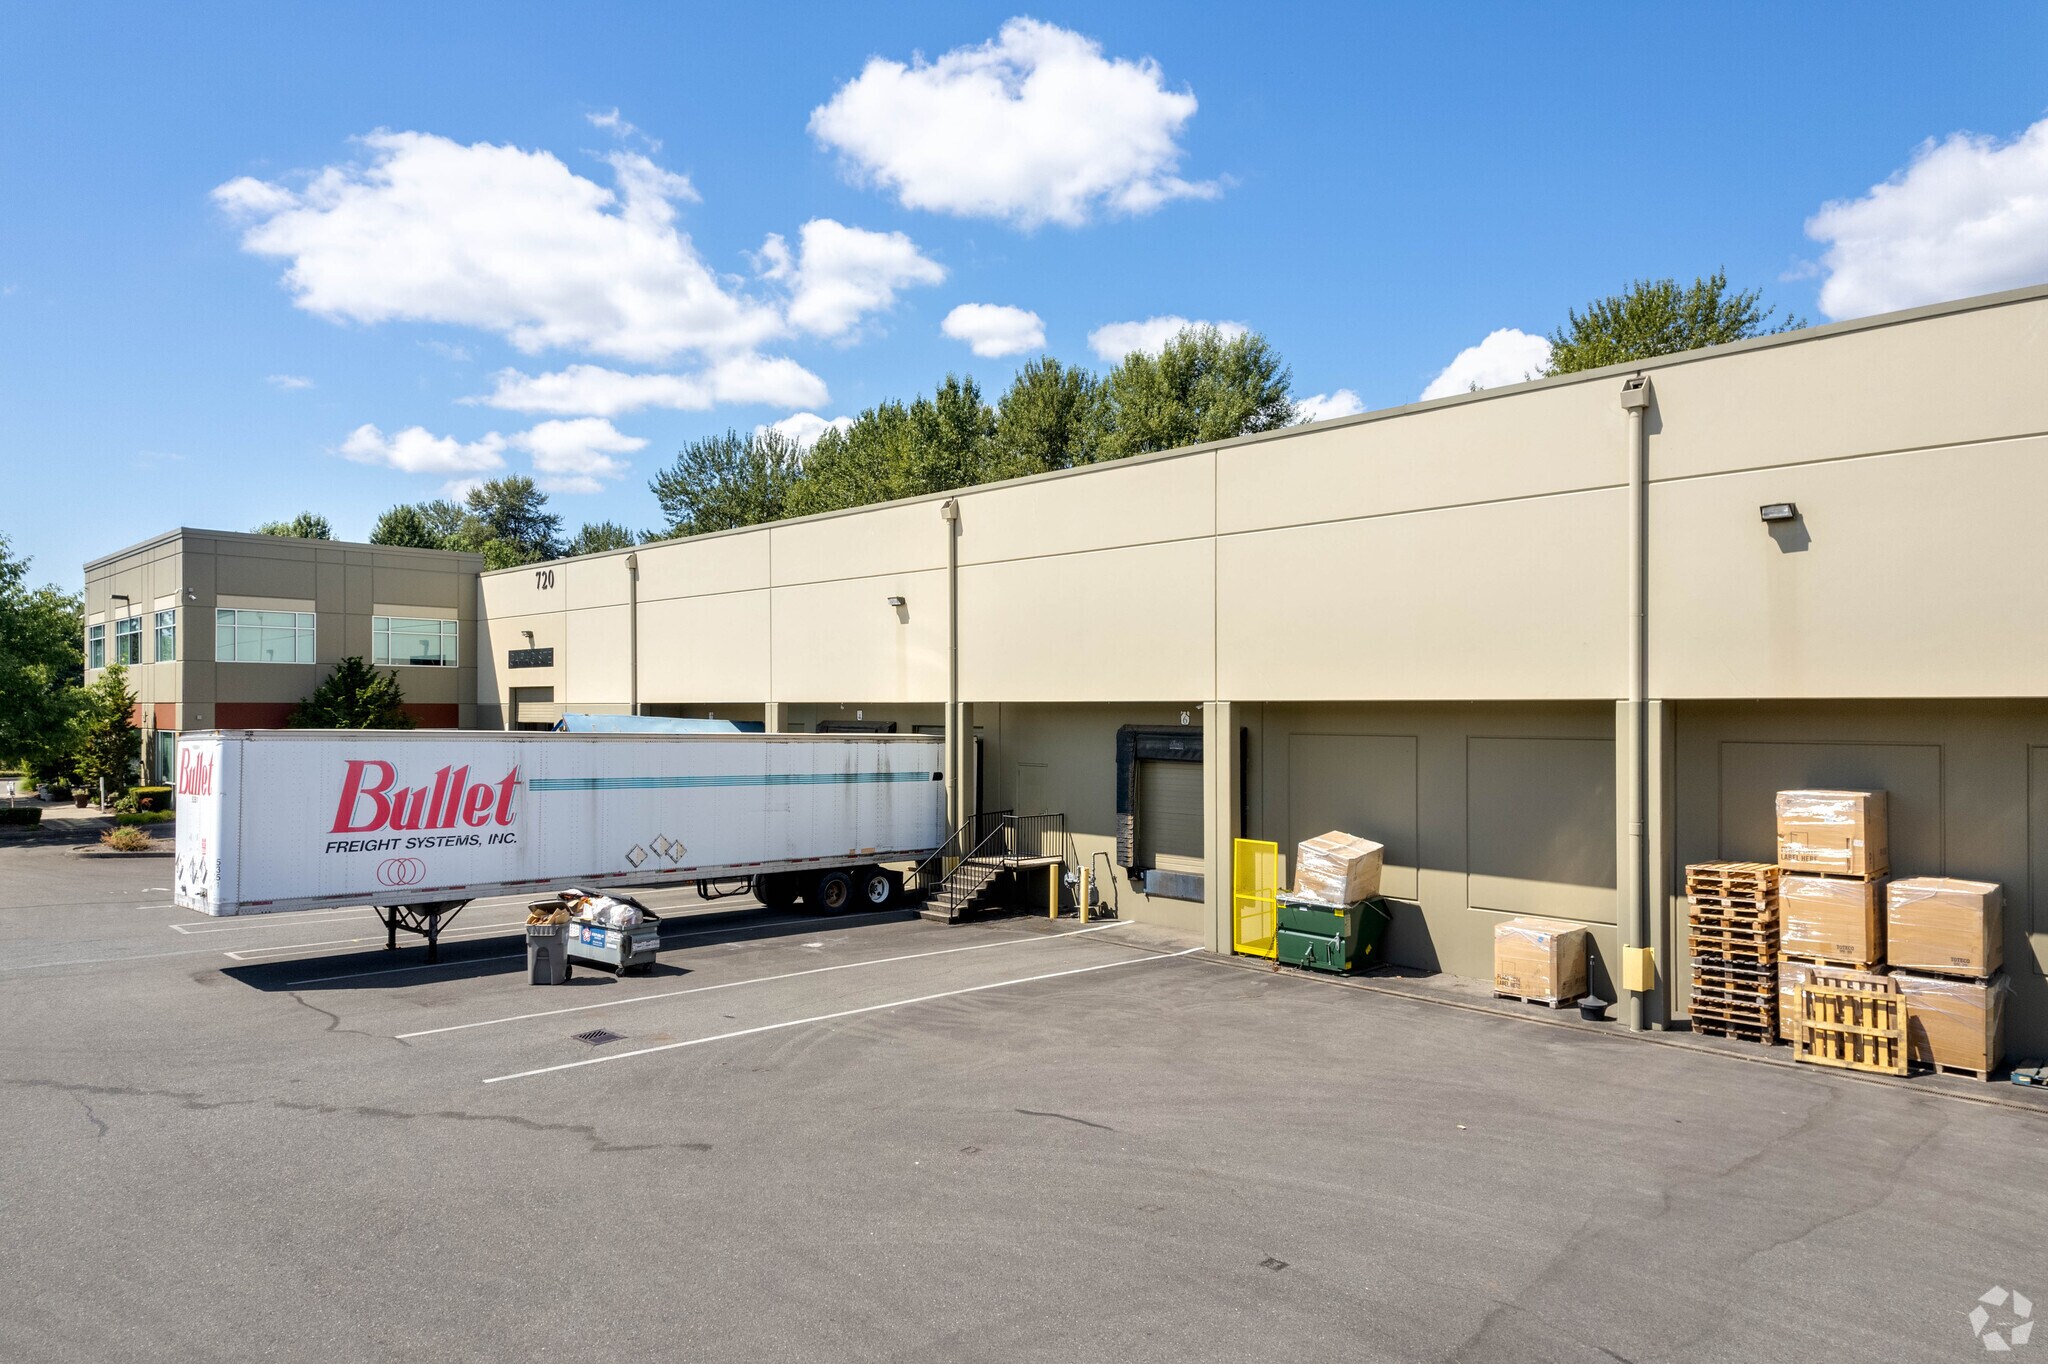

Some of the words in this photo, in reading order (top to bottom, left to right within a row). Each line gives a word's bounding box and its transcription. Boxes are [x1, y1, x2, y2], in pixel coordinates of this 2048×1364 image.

[535, 570, 554, 590] 720
[178, 747, 214, 797] Bullet
[327, 760, 523, 834] Bullet
[325, 838, 402, 854] FREIGHT
[405, 834, 482, 849] SYSTEMS,
[488, 832, 517, 845] INC.
